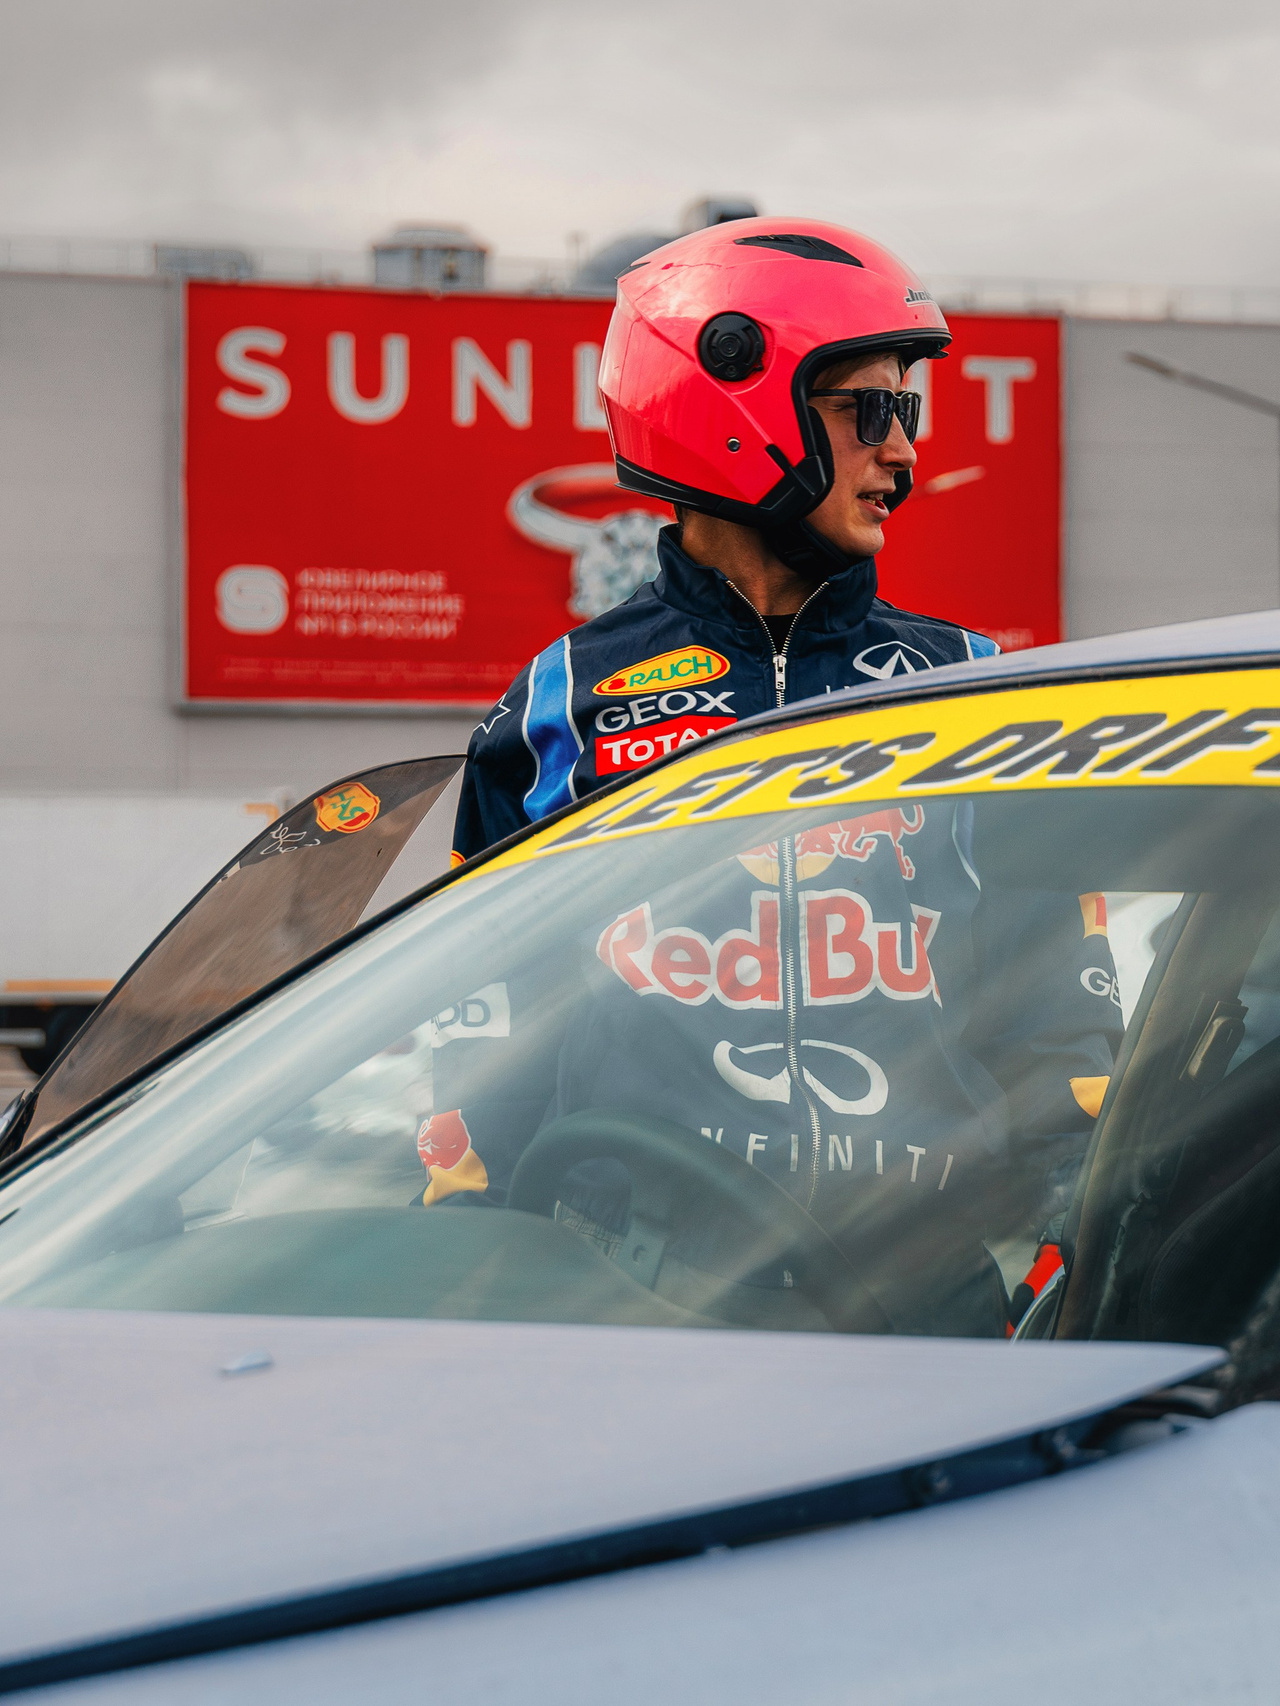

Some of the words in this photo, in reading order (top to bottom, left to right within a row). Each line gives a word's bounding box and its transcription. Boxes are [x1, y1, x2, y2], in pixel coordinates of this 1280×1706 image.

[216, 326, 1037, 445] SUNLT
[595, 690, 736, 733] GEOX
[628, 655, 713, 688] RAUCH
[602, 727, 720, 766] TOTA
[536, 732, 936, 854] LET'S
[597, 890, 783, 1010] Red
[798, 888, 942, 1008] Bu
